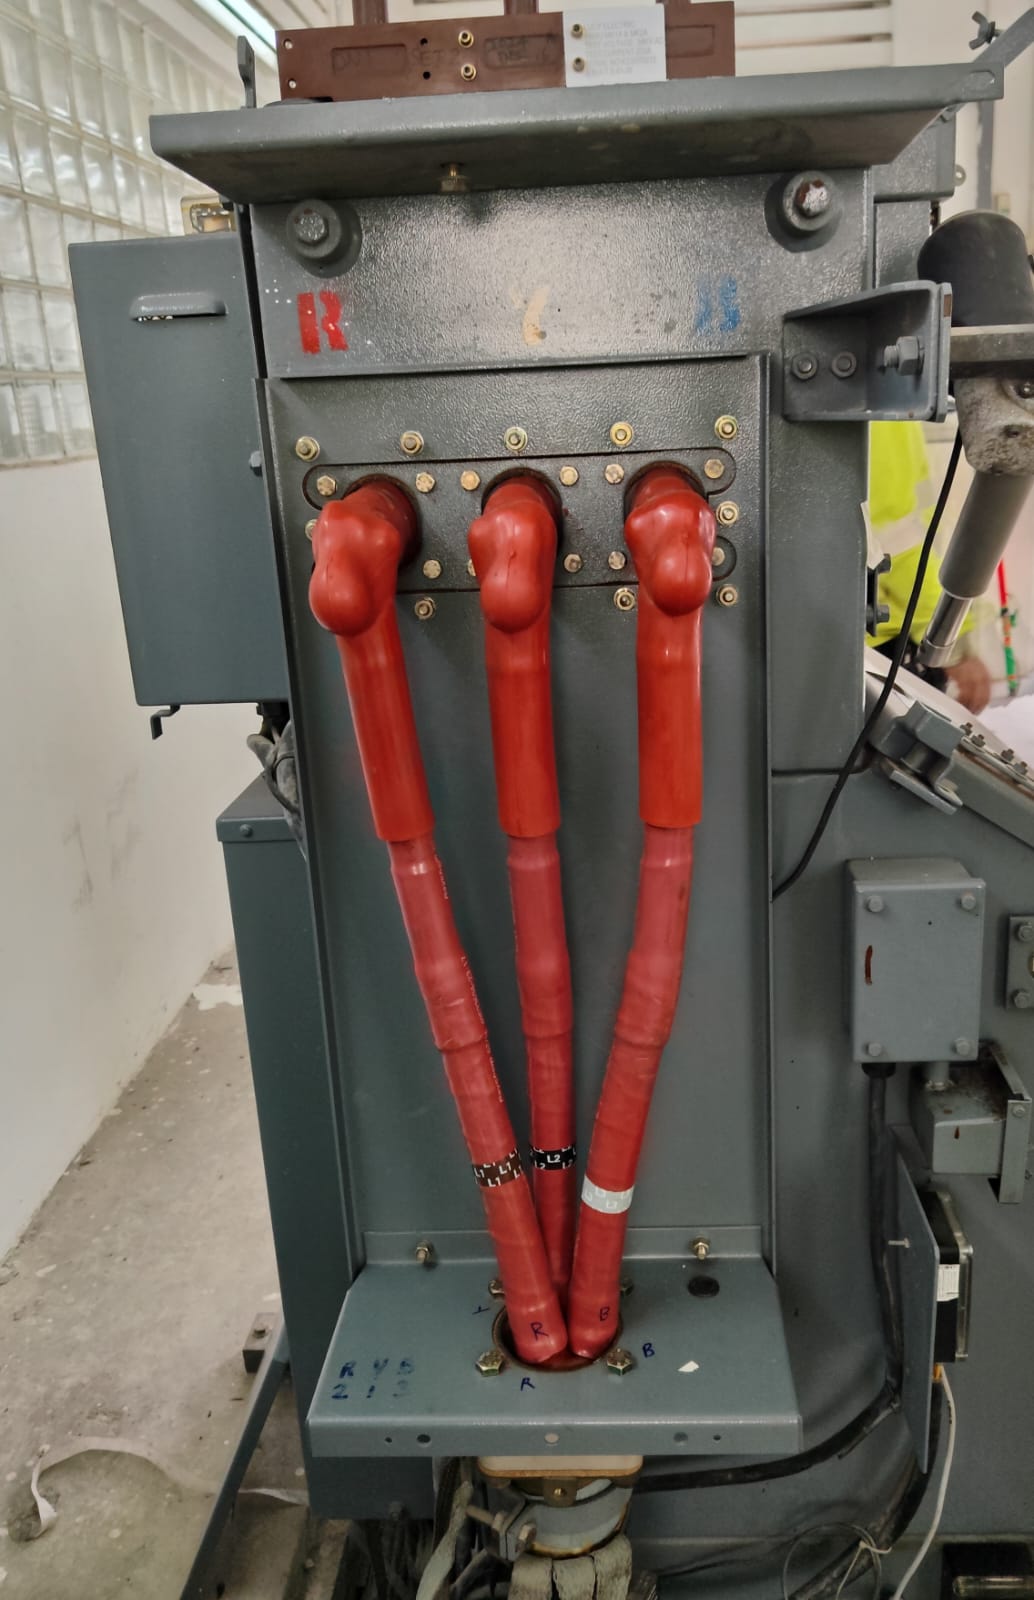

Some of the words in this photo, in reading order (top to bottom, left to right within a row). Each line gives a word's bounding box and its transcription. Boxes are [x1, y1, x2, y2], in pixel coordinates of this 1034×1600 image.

[297, 291, 349, 354] R
[546, 1154, 562, 1164] L2
[473, 1167, 485, 1178] L1
[498, 1161, 512, 1175] L1
[487, 1176, 502, 1188] L1
[599, 1306, 611, 1321] B
[530, 1321, 550, 1340] R
[642, 1342, 656, 1358] B
[339, 1359, 357, 1379] R
[331, 1383, 349, 1400] 2
[520, 1376, 536, 1392] R
